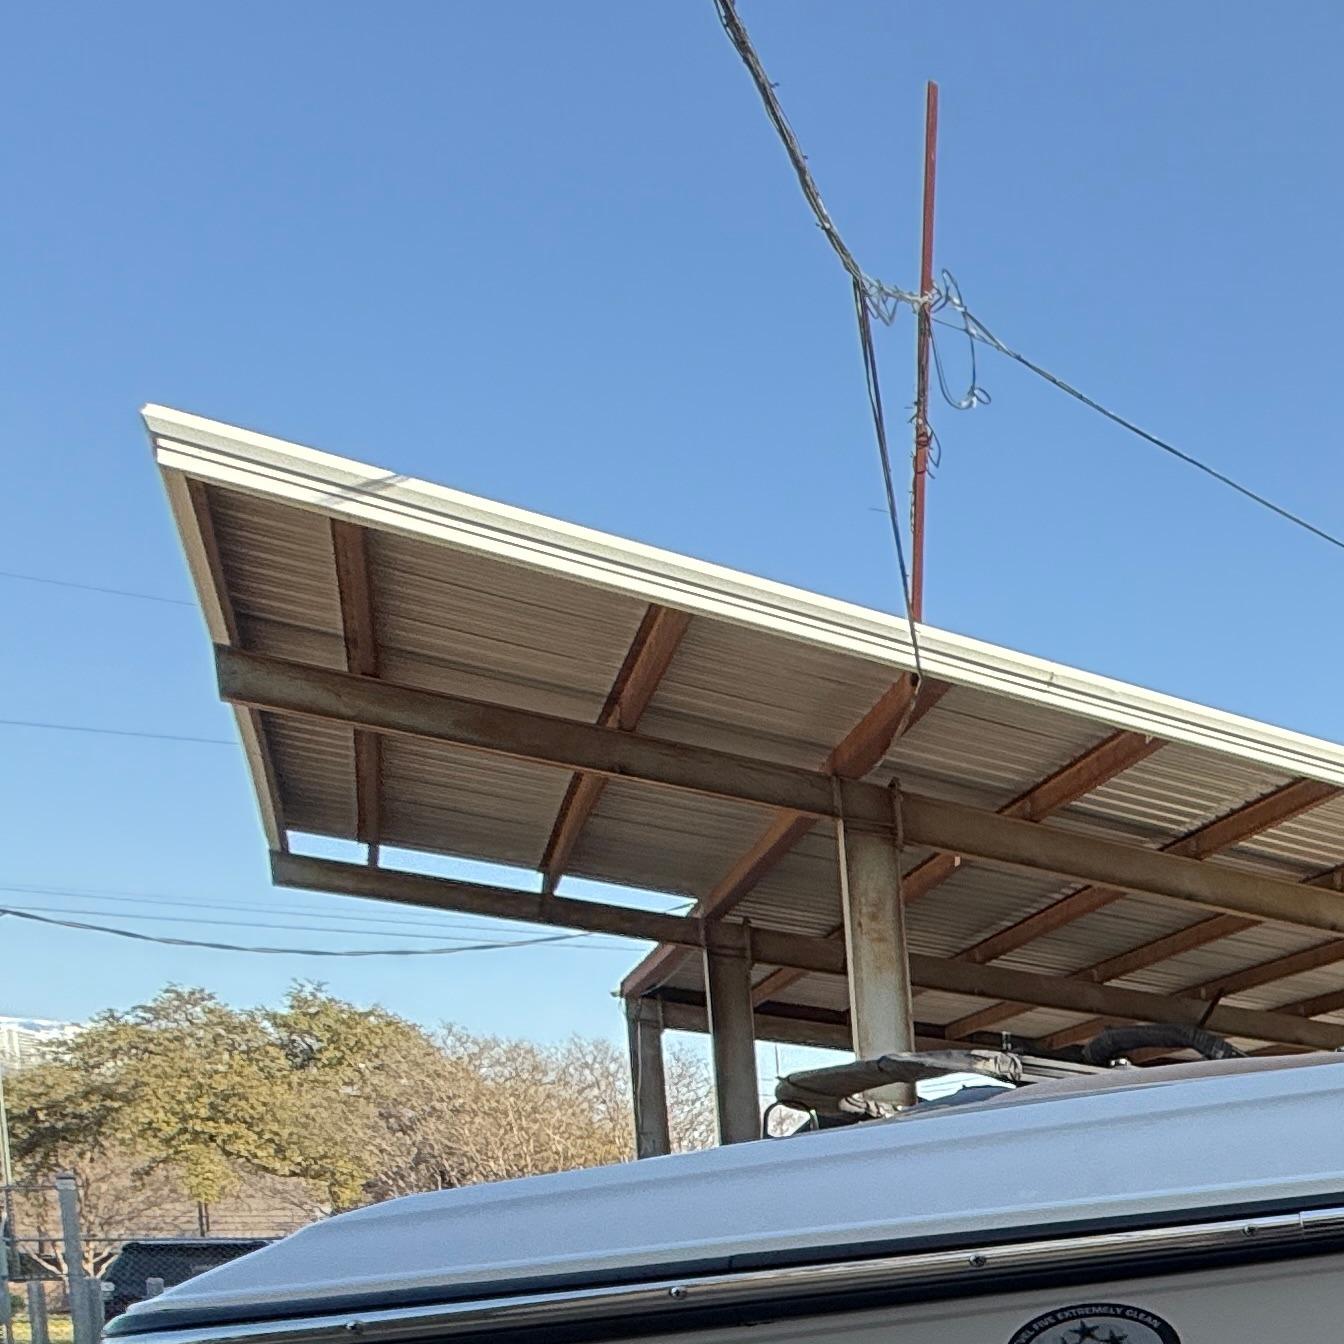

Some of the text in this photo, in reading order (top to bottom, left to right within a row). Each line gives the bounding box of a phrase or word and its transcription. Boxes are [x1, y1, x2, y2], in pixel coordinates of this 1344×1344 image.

[1032, 1315, 1057, 1332] FIVE
[1057, 1306, 1123, 1320] EXTREMELY
[1125, 1309, 1162, 1329] CLEAN
